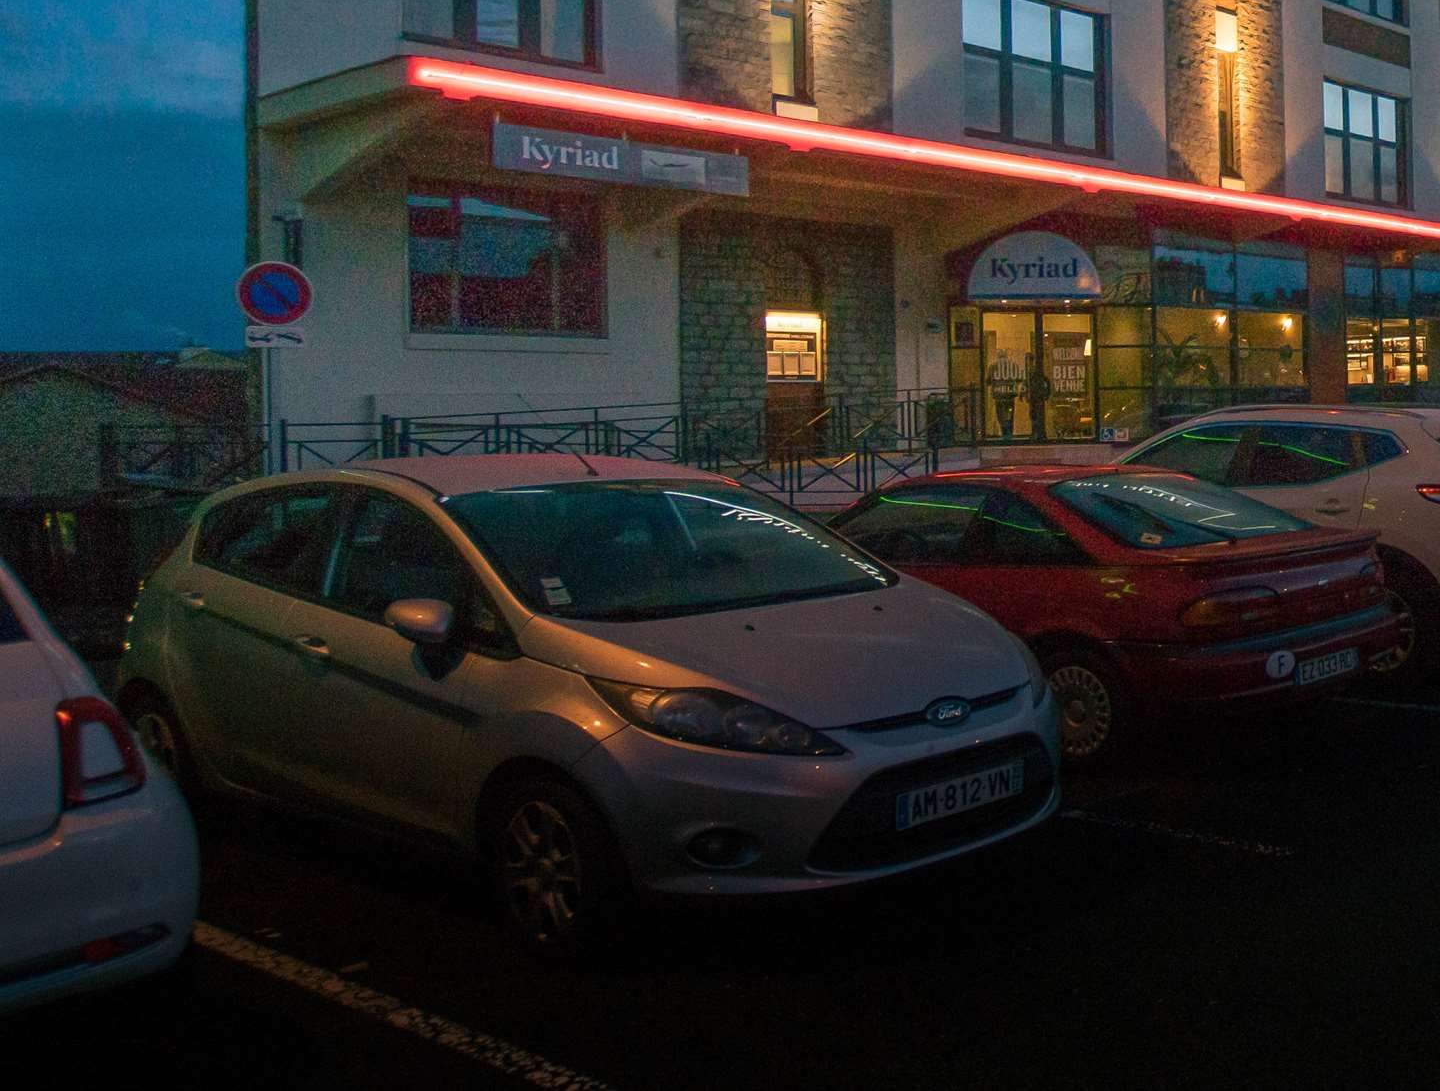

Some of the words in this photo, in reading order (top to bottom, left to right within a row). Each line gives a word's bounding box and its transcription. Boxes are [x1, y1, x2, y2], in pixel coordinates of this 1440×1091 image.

[521, 135, 619, 170] Kyriad
[990, 257, 1078, 284] Kyriad
[1053, 365, 1086, 379] BIEN
[1278, 654, 1286, 675] F
[938, 704, 962, 720] Ford
